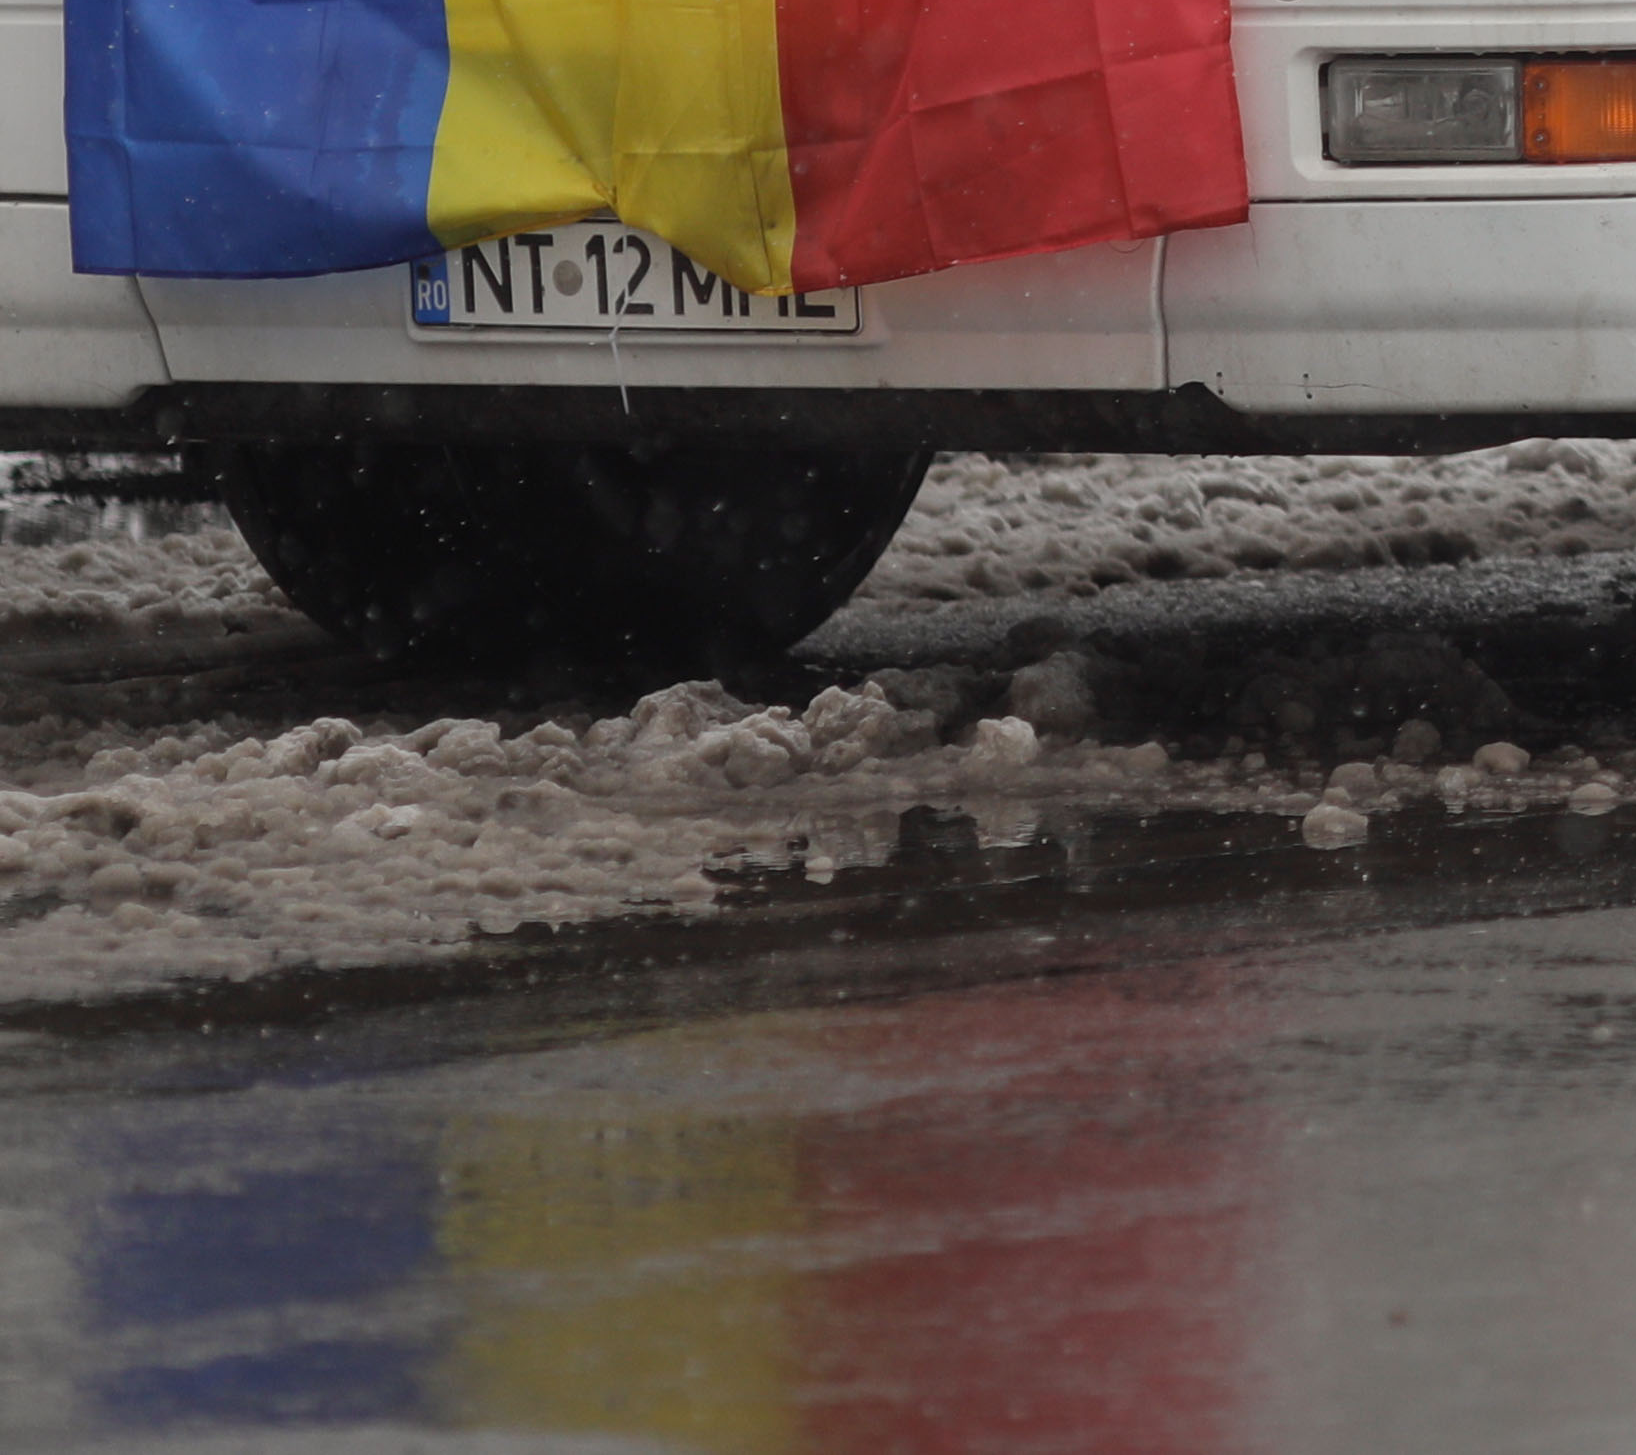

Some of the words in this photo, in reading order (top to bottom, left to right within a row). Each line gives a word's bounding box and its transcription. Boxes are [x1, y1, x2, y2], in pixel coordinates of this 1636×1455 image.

[416, 275, 447, 312] RO
[460, 232, 554, 315] NT
[584, 233, 655, 317] 12
